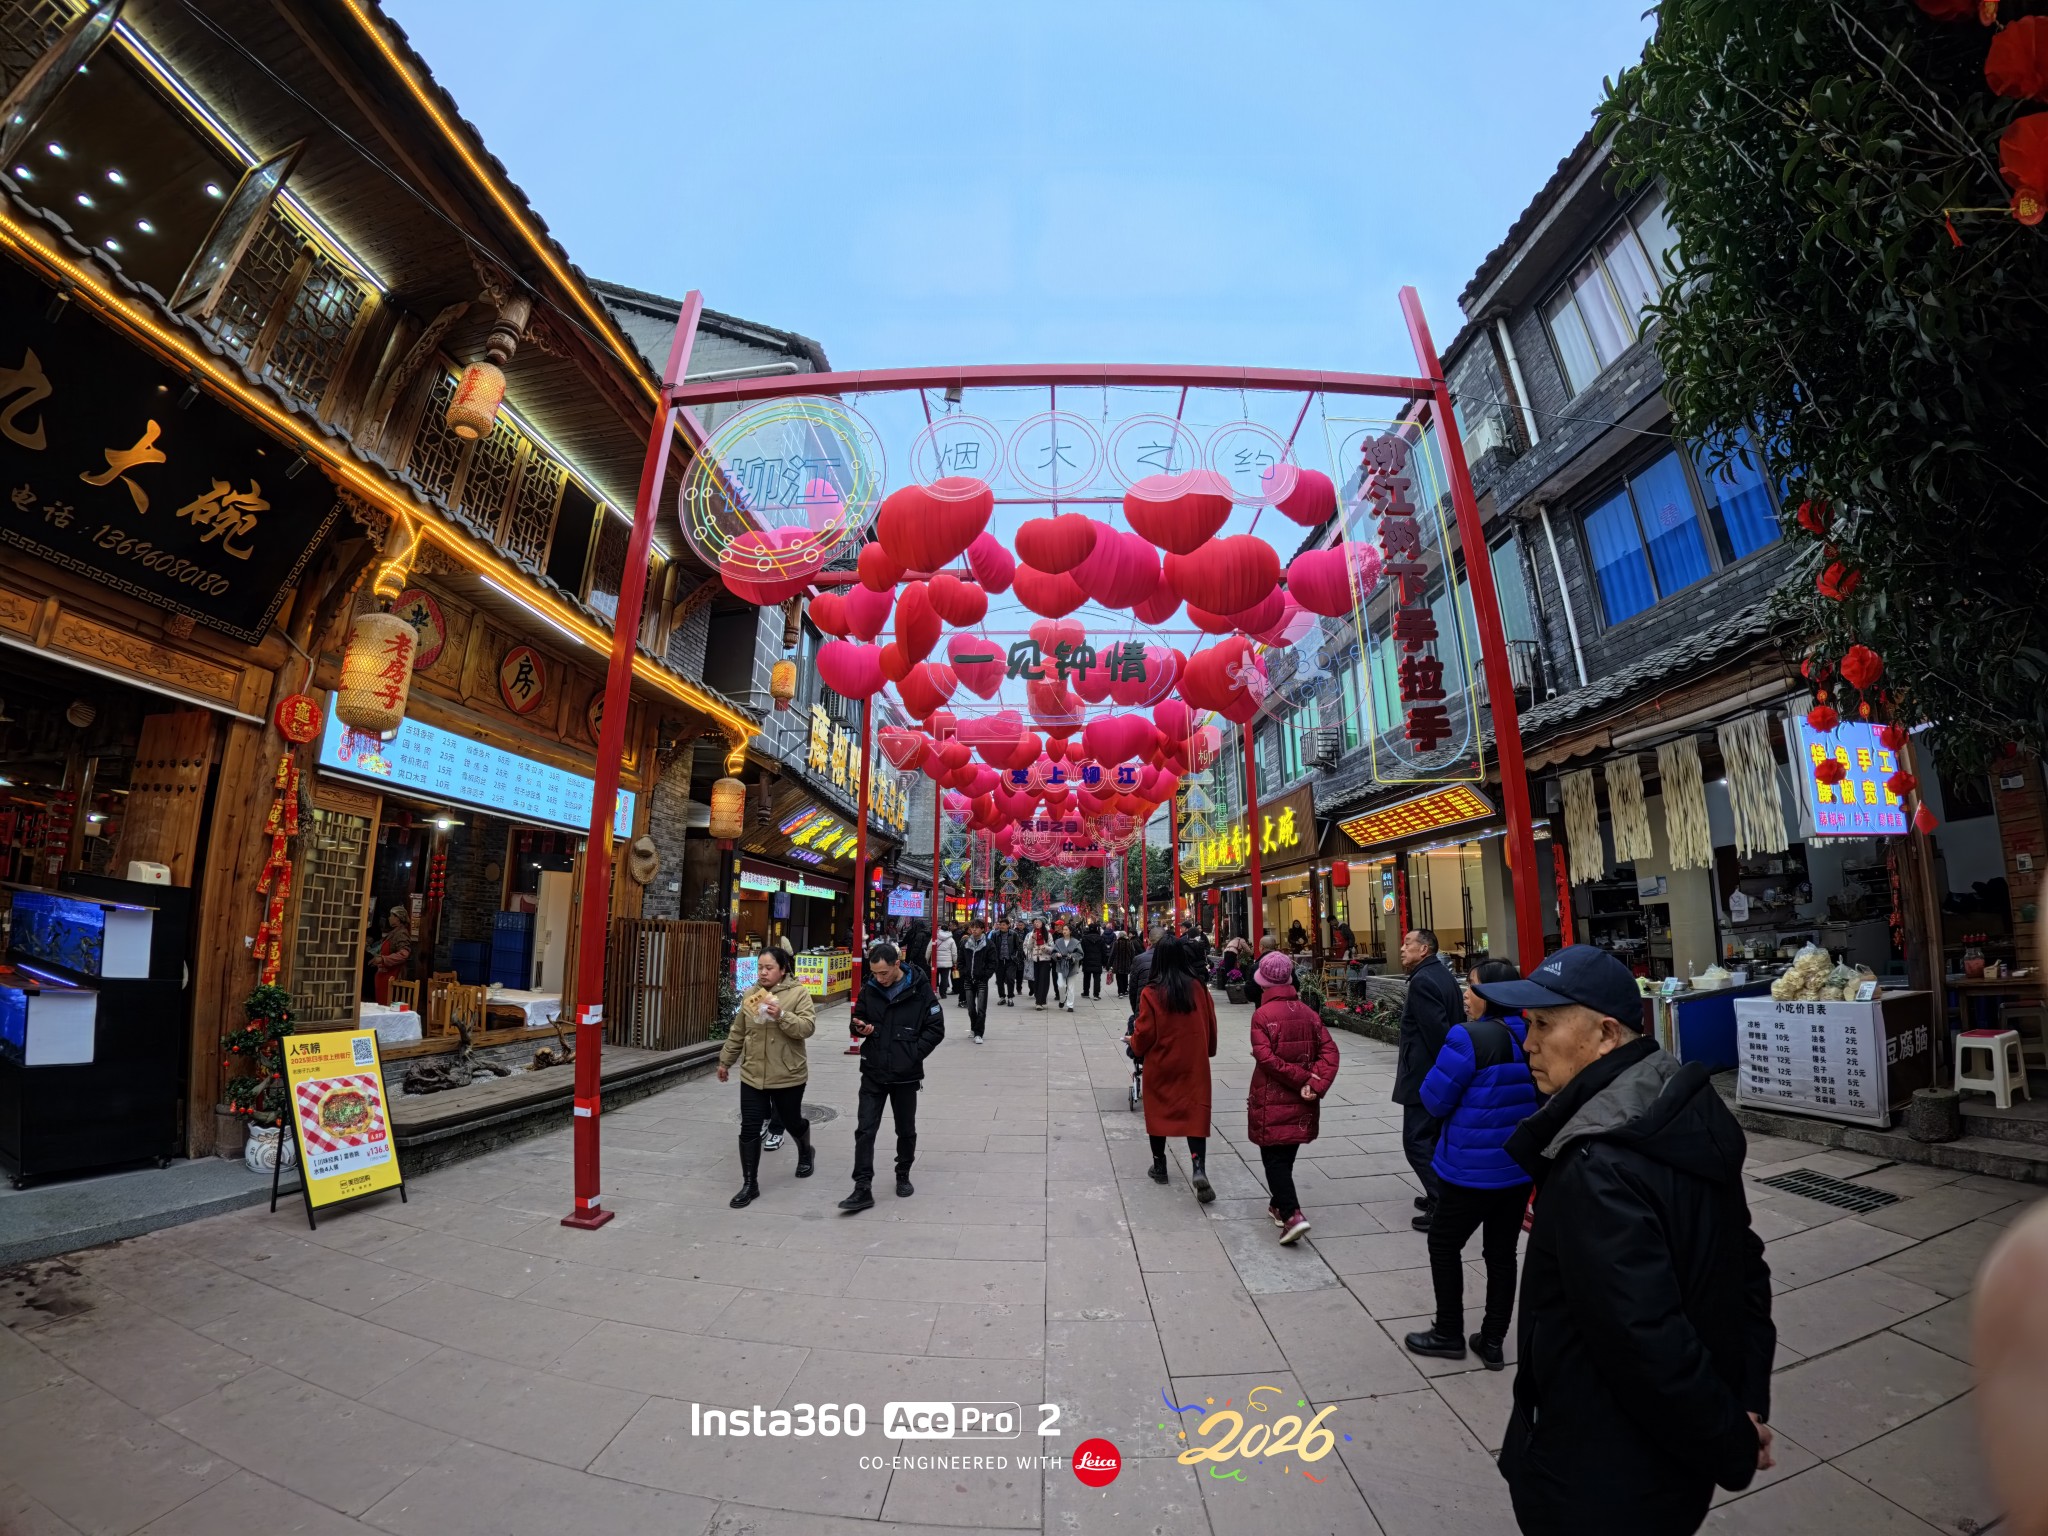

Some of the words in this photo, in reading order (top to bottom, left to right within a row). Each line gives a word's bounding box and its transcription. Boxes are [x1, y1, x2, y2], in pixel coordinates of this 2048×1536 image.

[719, 455, 841, 513] 柳江
[954, 639, 1149, 683] 一见钟情
[372, 633, 413, 710] 老房子
[510, 655, 535, 700] 房
[1011, 766, 1136, 784] 爱上柳江
[1776, 1003, 1827, 1015] 小吃价目表
[1811, 1024, 1824, 1033] 豆浆
[1844, 1026, 1856, 1034] 2元
[1811, 1035, 1825, 1043] 油条
[1845, 1037, 1857, 1045] 2元
[1886, 1025, 1927, 1065] 豆腐脑
[290, 1042, 320, 1056] 人气榜
[1776, 1045, 1790, 1053] 10元
[1846, 1047, 1858, 1055] 2元
[1750, 1054, 1768, 1063] 牛肉粉
[1777, 1056, 1791, 1064] 12元
[1812, 1055, 1826, 1064] 馒头
[1847, 1058, 1858, 1066] 2元
[1778, 1068, 1791, 1076] 12元
[1813, 1065, 1827, 1074] 包子
[1847, 1068, 1866, 1077] 2.5元
[1778, 1079, 1792, 1087] 12元
[1848, 1079, 1859, 1087] 5元
[1778, 1090, 1793, 1098] 12元
[1848, 1089, 1860, 1097] 8元
[1849, 1099, 1865, 1108] 12元
